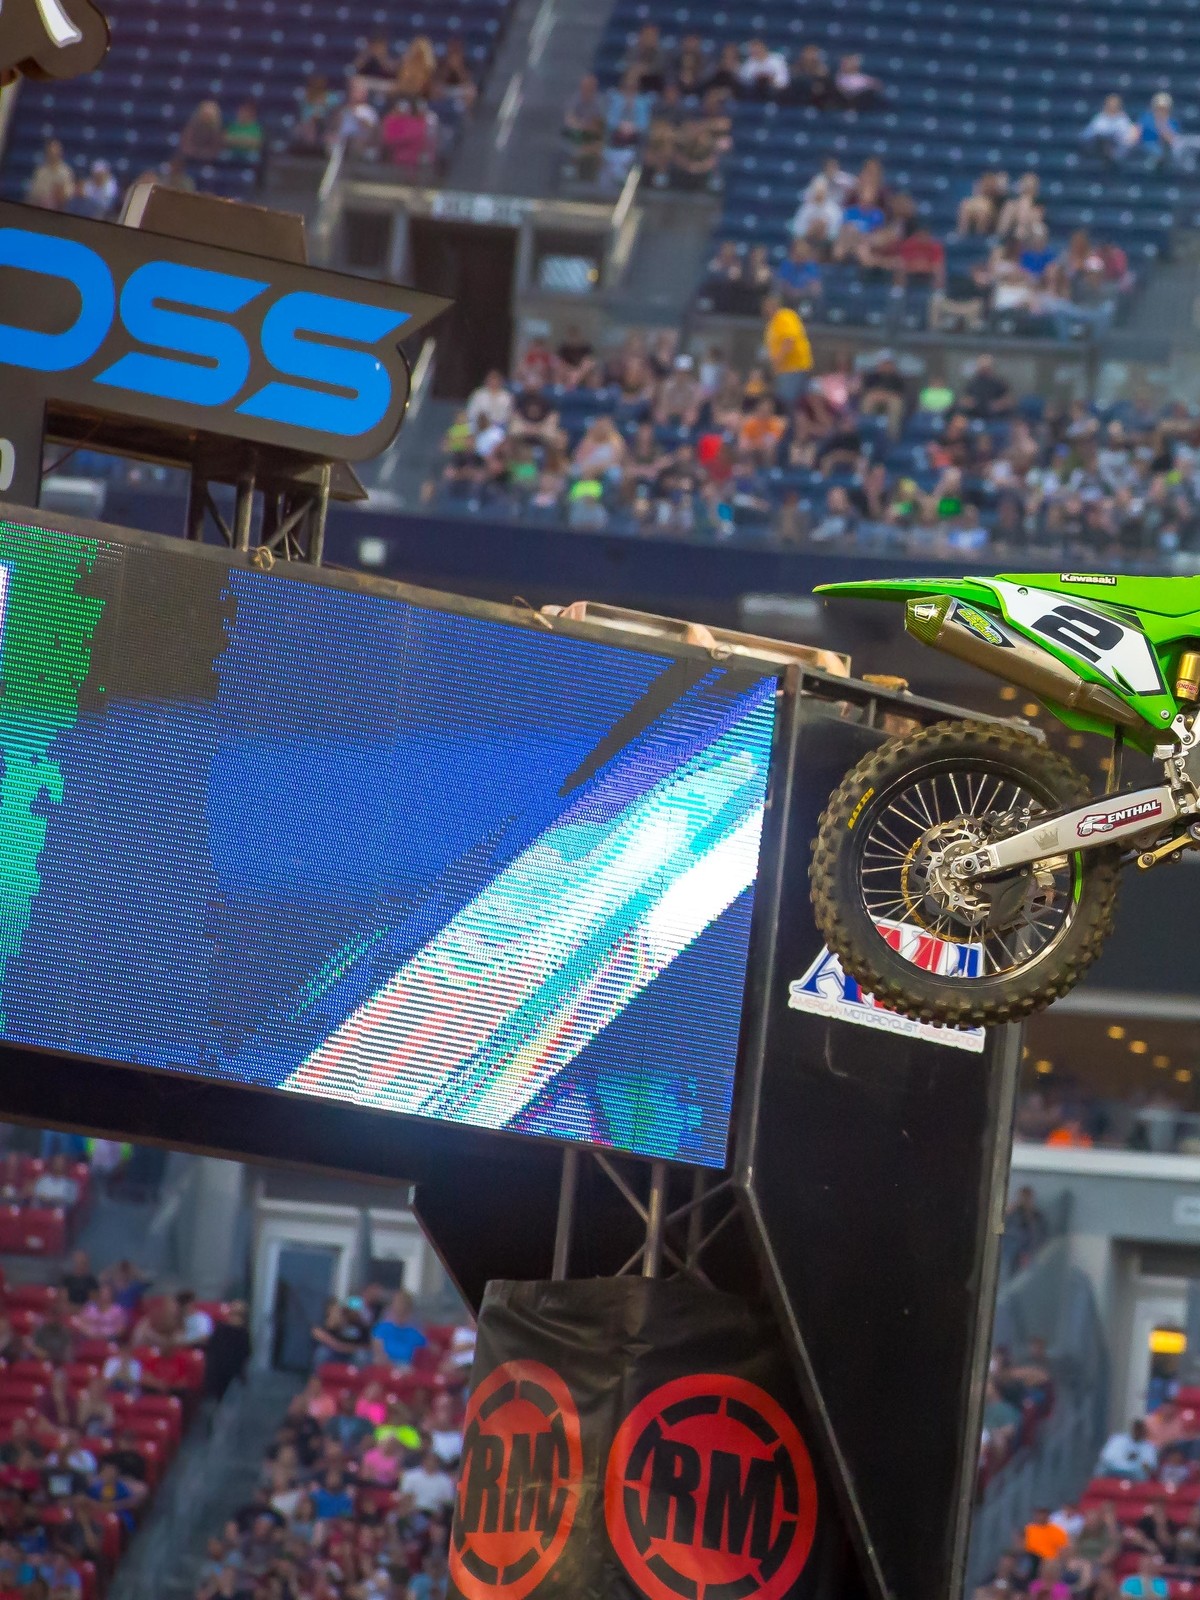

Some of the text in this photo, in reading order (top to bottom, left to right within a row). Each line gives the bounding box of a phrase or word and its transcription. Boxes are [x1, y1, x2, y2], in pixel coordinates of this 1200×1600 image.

[1062, 573, 1115, 585] Kawasaki
[1031, 605, 1124, 663] 2
[843, 1006, 919, 1034] MOTORCYCLIST
